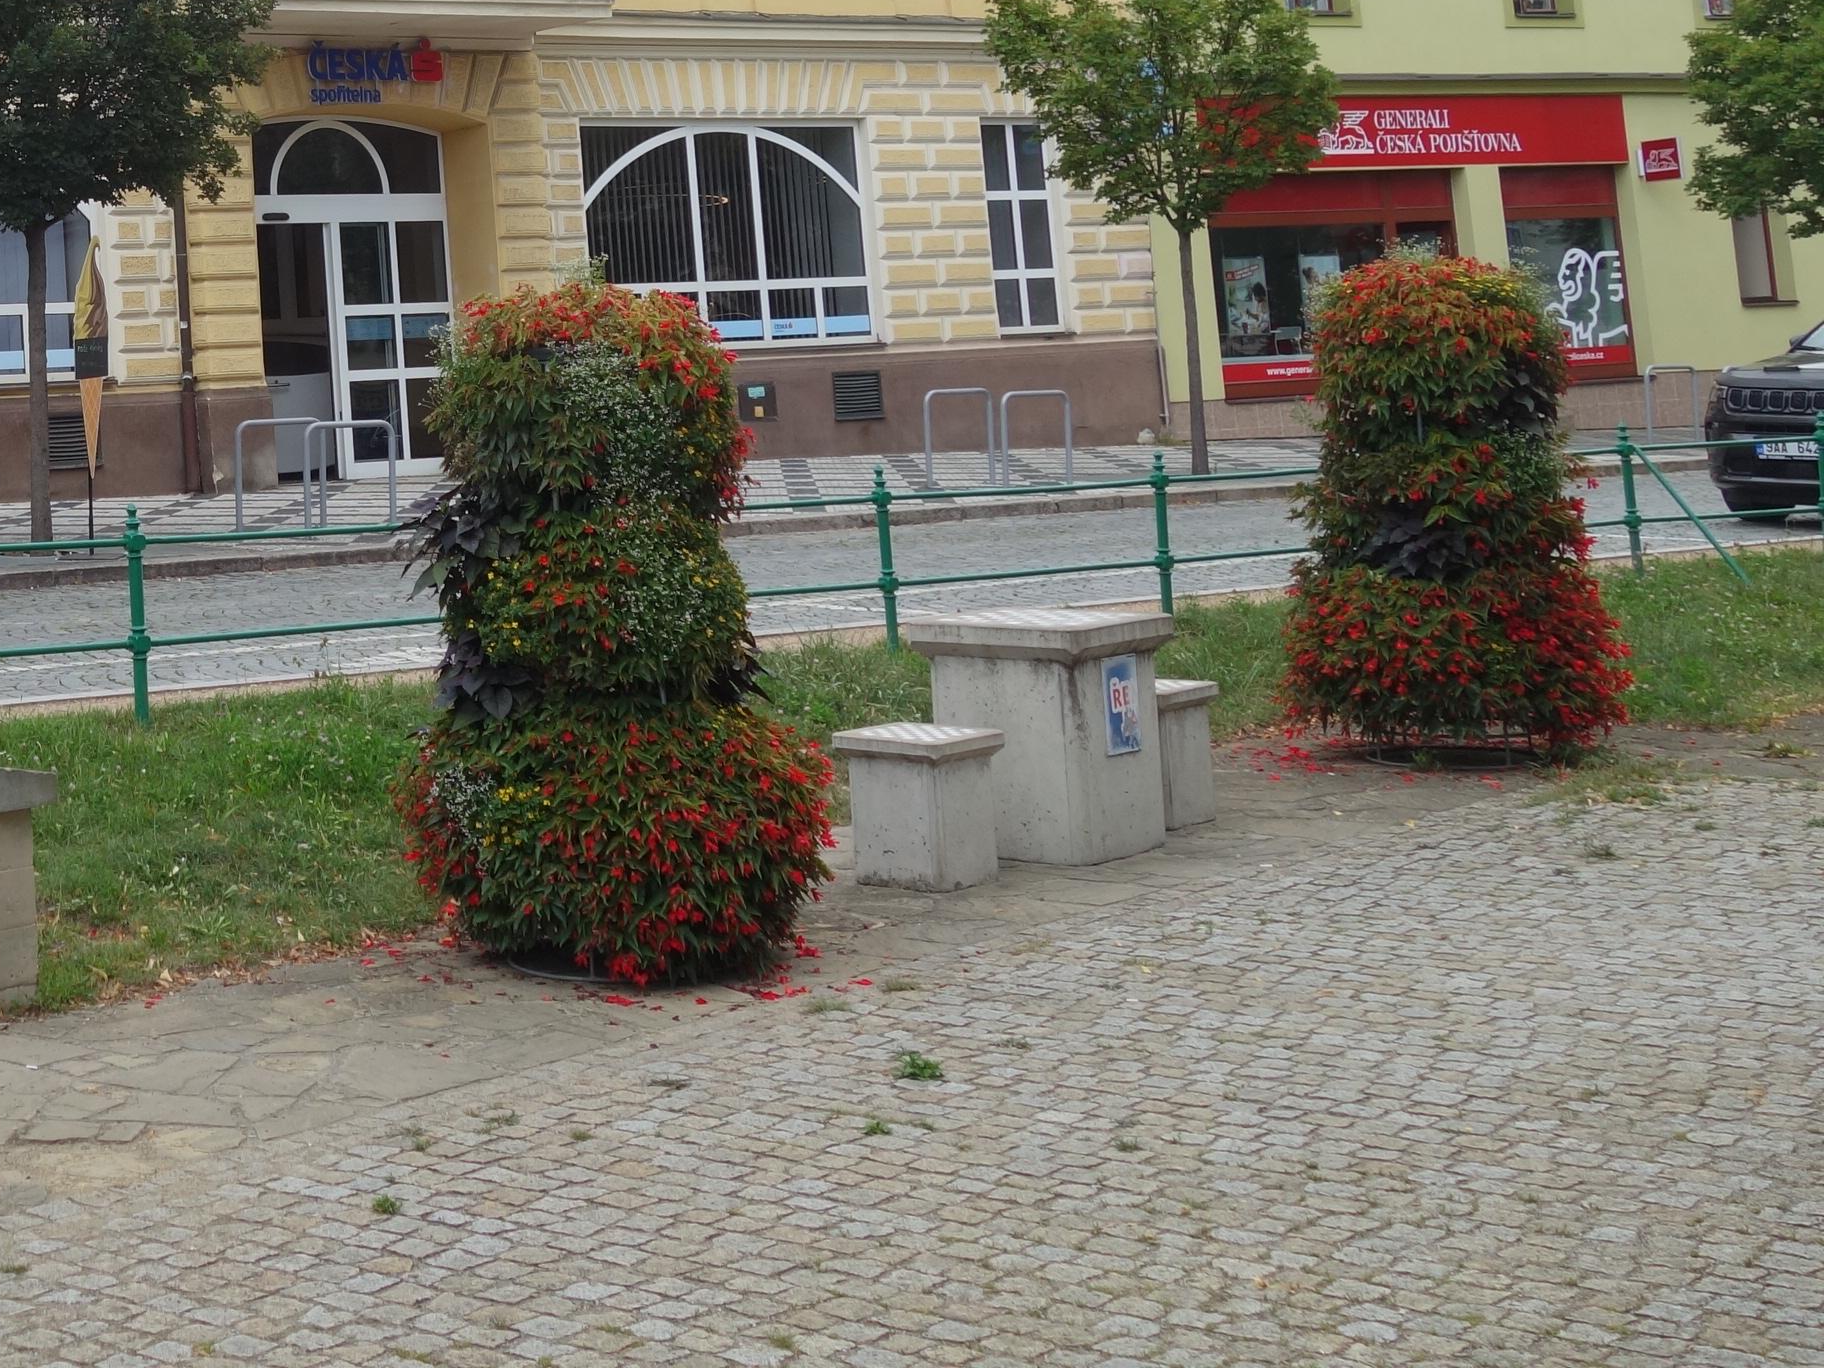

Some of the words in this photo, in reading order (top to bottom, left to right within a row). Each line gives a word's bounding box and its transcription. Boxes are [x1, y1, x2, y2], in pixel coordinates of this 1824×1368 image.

[308, 40, 408, 81] ČESKÁ
[310, 85, 382, 105] spořitelna
[1374, 109, 1450, 129] GENERALI
[1376, 131, 1426, 154] ČESKÁ
[1429, 130, 1522, 153] POJIŠŤOVNA
